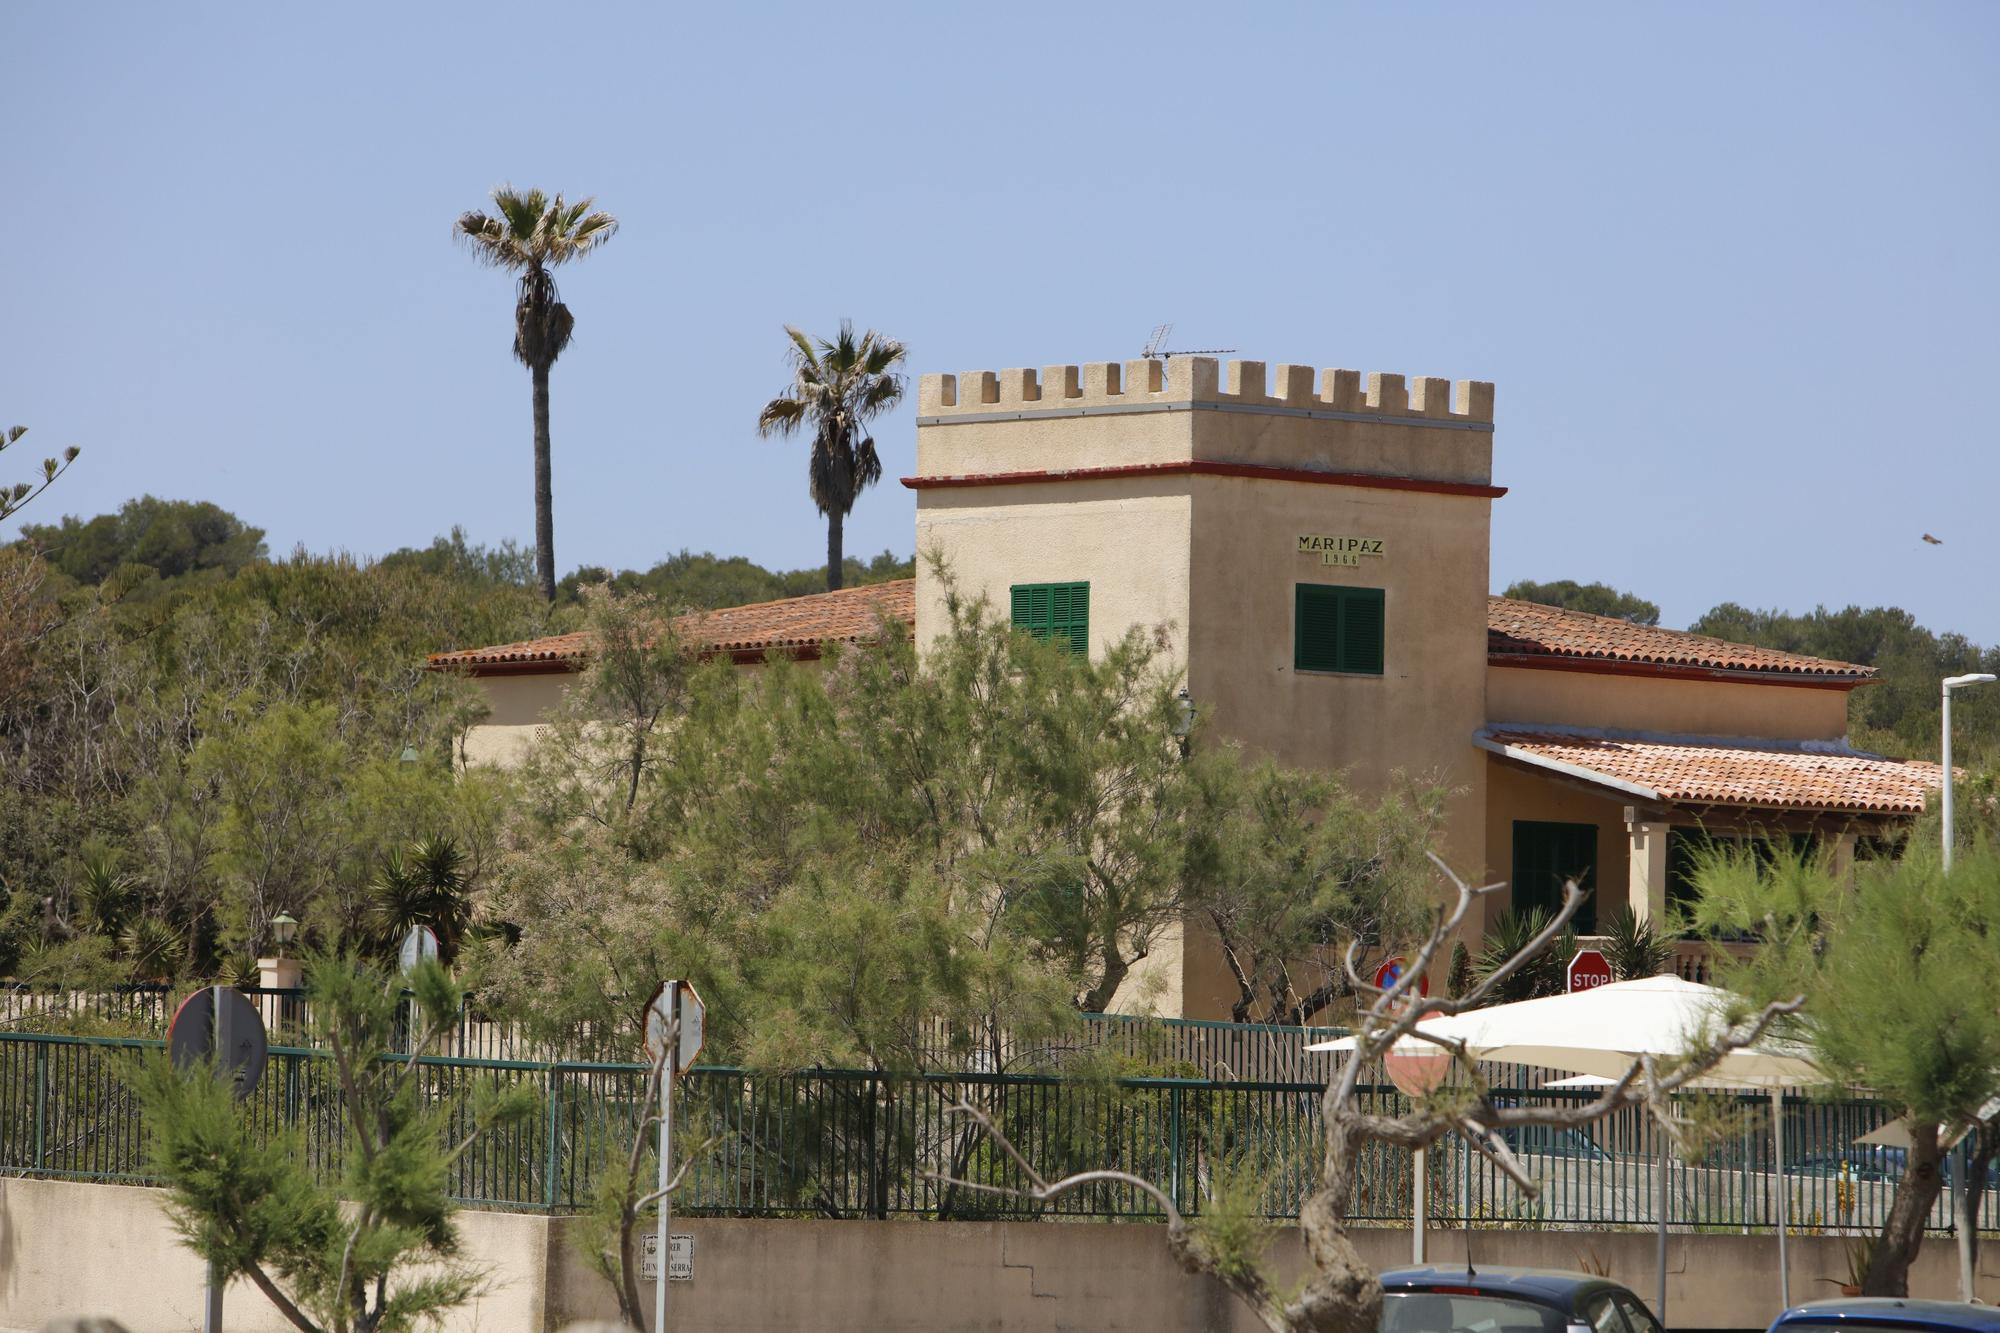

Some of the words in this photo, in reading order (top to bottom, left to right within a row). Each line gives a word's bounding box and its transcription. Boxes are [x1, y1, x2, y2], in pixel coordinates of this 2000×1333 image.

[1299, 537, 1383, 553] MARIPAZ
[1574, 973, 1608, 987] STOP
[671, 1263, 690, 1271] SERRA
